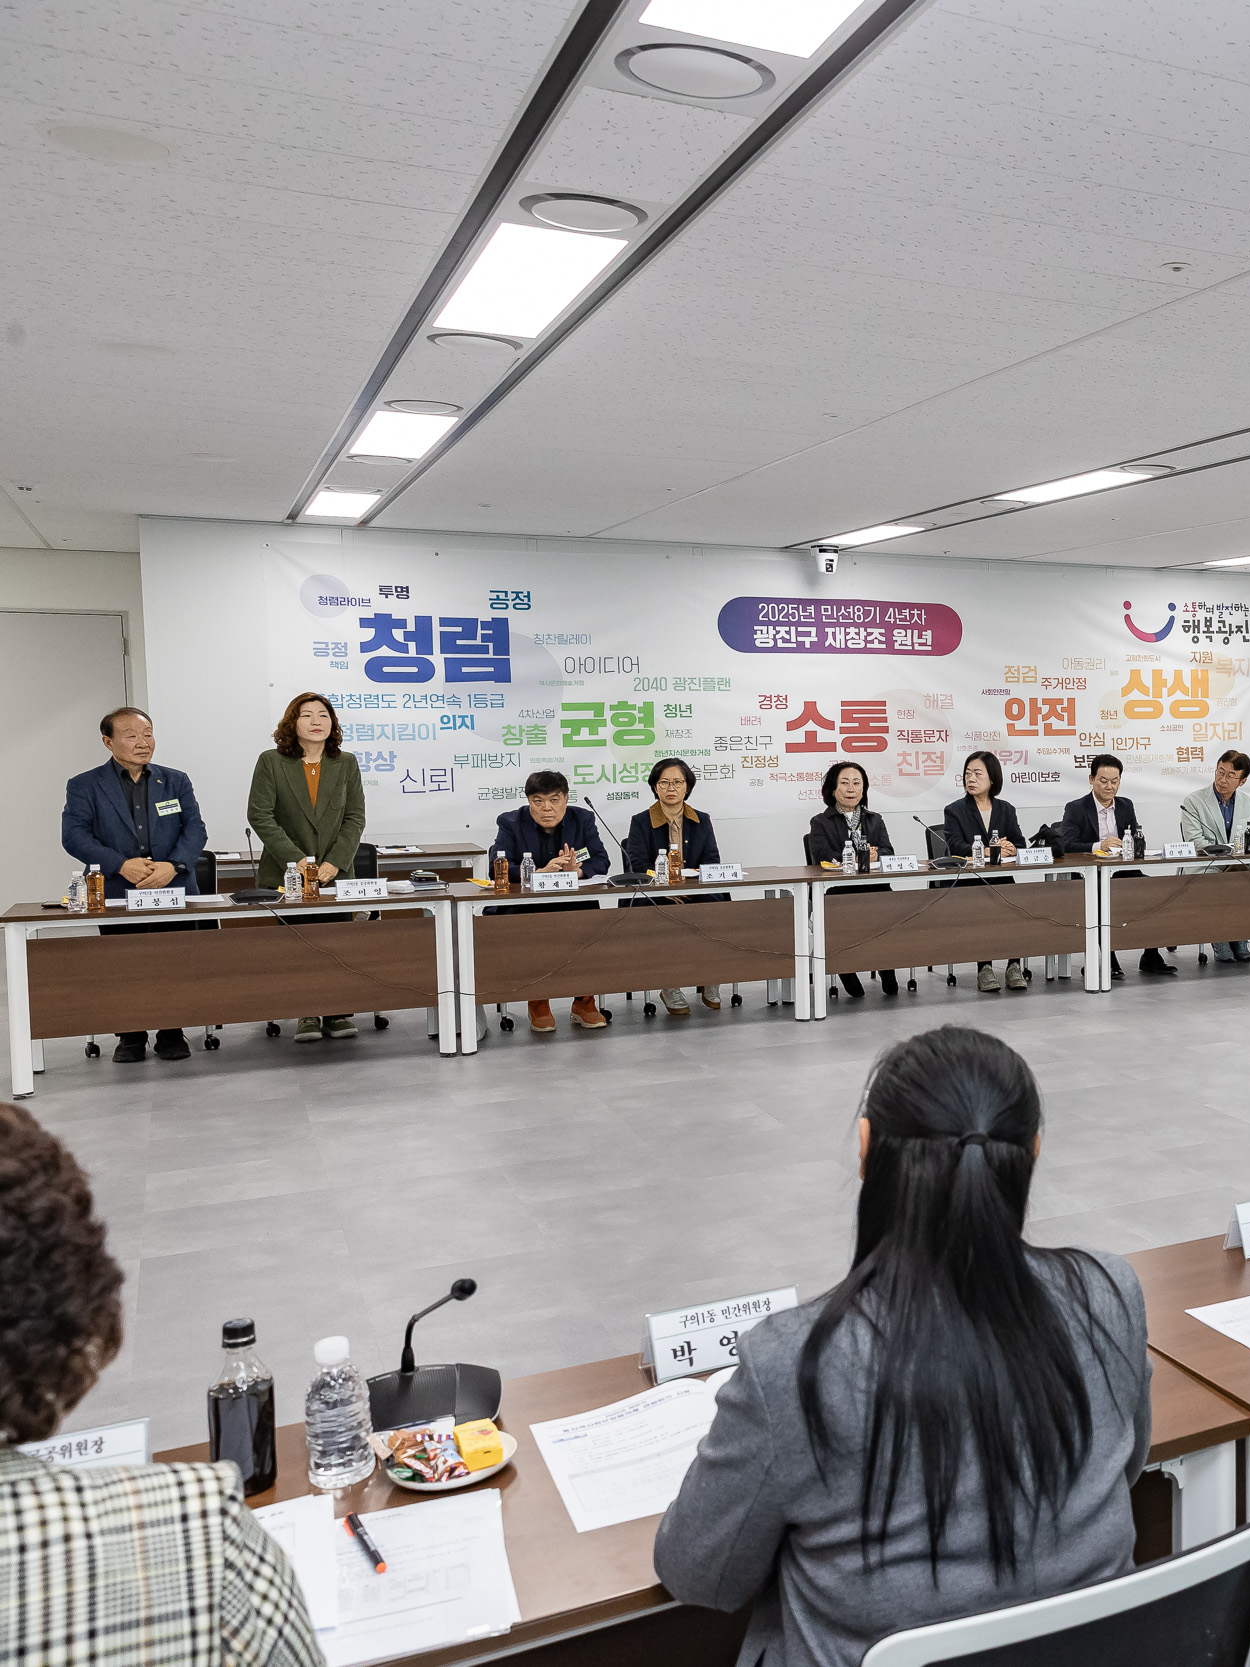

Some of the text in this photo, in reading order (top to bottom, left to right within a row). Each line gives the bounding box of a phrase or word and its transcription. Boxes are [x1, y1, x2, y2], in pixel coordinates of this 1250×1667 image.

[378, 585, 410, 599] 투명
[489, 590, 532, 610] 공정
[317, 596, 372, 607] 청렴라이브
[758, 603, 927, 625] 2025년 민선8기 4년차
[1183, 602, 1250, 618] 소통하며 발전하는
[533, 633, 592, 645] 칭찬릴레이
[753, 625, 933, 650] 광진구 재창조 원년
[1182, 617, 1250, 645] 행복광진
[312, 641, 349, 657] 긍정
[359, 613, 511, 683] 청렴
[330, 660, 349, 670] 책임
[564, 656, 640, 674] 아이디어
[1062, 658, 1106, 670] 아동권리
[1190, 651, 1213, 664] 지원
[1004, 665, 1038, 683] 점검
[1215, 657, 1250, 677] 복지
[633, 677, 731, 692] 2040 광진플랜
[1041, 678, 1087, 690] 주거안정
[318, 693, 505, 709] 합청렴도 2년연속 1등급
[758, 694, 788, 710] 경청
[923, 693, 955, 710] 해결
[1121, 669, 1209, 719] 상생
[518, 709, 555, 719] 4차산업
[663, 704, 693, 719] 청년
[896, 709, 915, 719] 현장
[1005, 697, 1076, 736] 안전
[1100, 710, 1118, 720] 청년
[440, 714, 475, 731] 의지
[560, 701, 656, 747] 균형
[740, 716, 762, 726] 배려
[785, 701, 890, 753] 소통
[1160, 724, 1184, 732] 소상공인
[501, 724, 548, 746] 창출
[664, 729, 693, 738] 재창조
[896, 729, 950, 743] 직통문자
[964, 731, 1001, 741] 식품안전
[1079, 732, 1106, 747] 안심
[1192, 722, 1243, 742] 일자리
[713, 735, 774, 751] 좋은친구
[1111, 737, 1151, 750] 1인가구
[453, 752, 521, 769] 부패방지
[653, 749, 711, 757] 청년지식문화거점
[1176, 746, 1204, 762] 협력
[353, 751, 397, 773] 향상
[740, 756, 779, 769] 진정성
[896, 751, 946, 777] 친절
[399, 766, 455, 794] 신뢰
[689, 764, 736, 780] 술문화
[769, 772, 823, 782] 적극소통행정
[1011, 772, 1061, 783] 어린이보호
[749, 778, 763, 786] 공정
[606, 791, 640, 800] 성장동력
[679, 1298, 772, 1329] 구의1동 민간위원장
[670, 1330, 739, 1367] 박영
